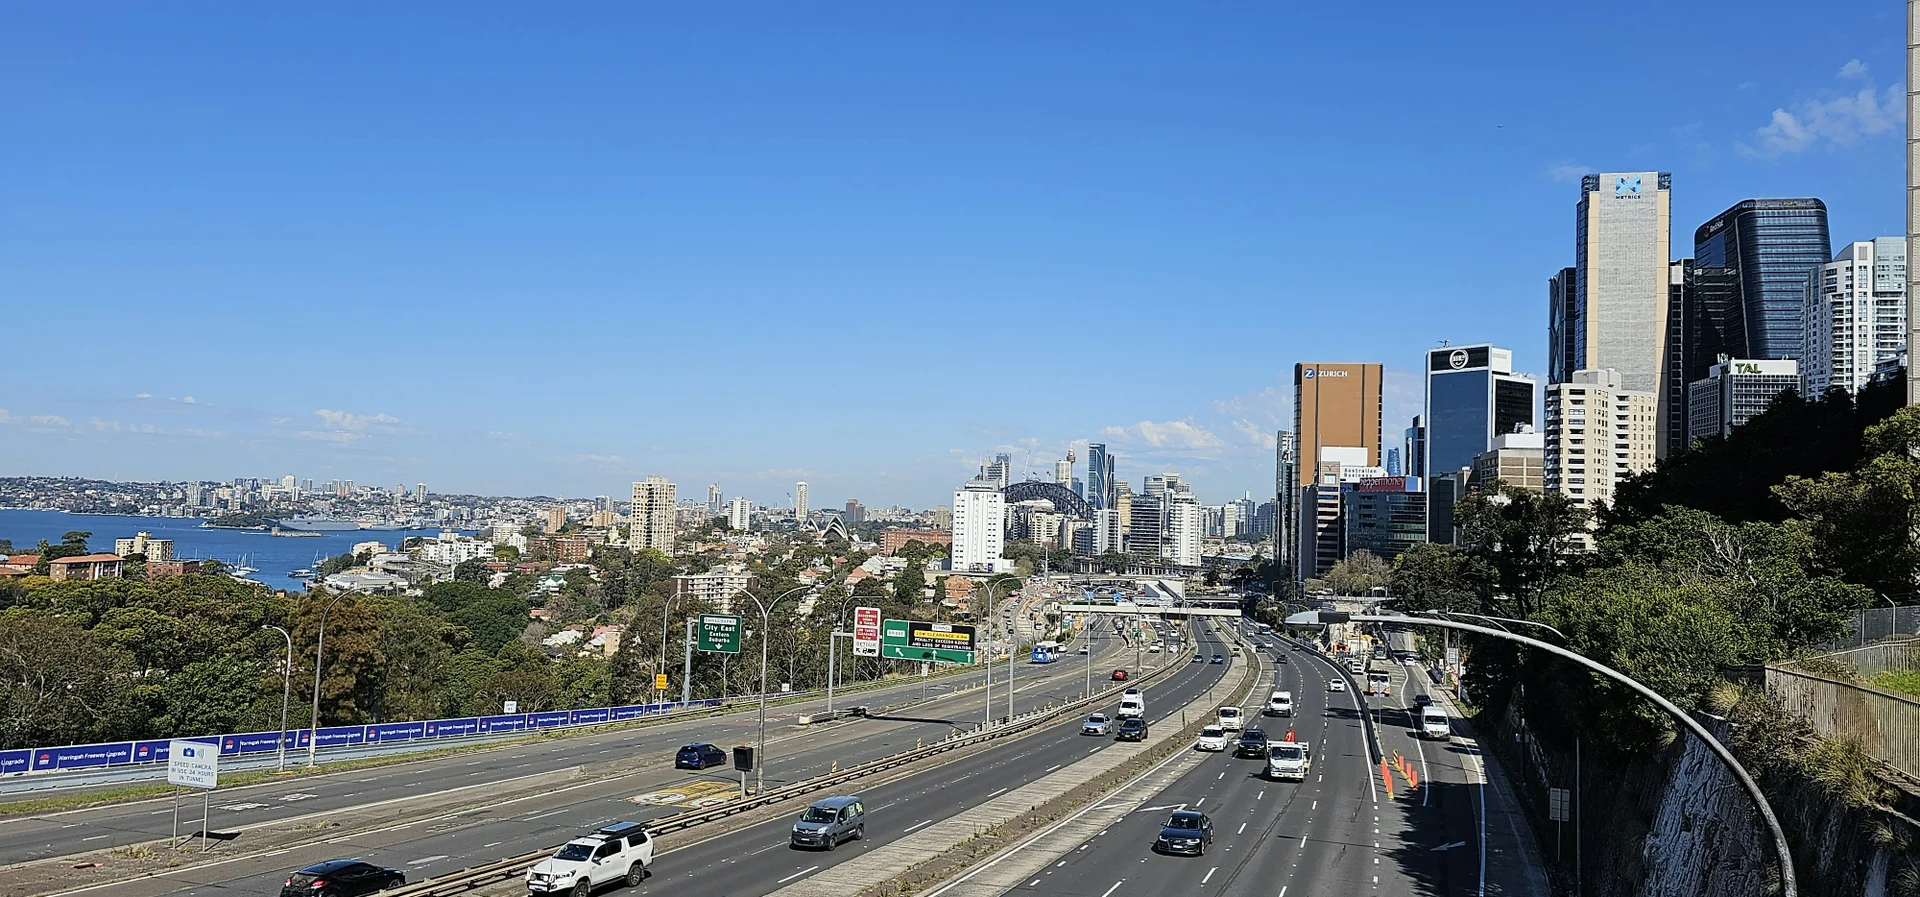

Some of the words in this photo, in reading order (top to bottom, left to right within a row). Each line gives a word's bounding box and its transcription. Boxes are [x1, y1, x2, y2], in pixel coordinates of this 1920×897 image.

[1735, 363, 1762, 374] TAL
[704, 624, 718, 632] City
[59, 753, 84, 761] Warringah
